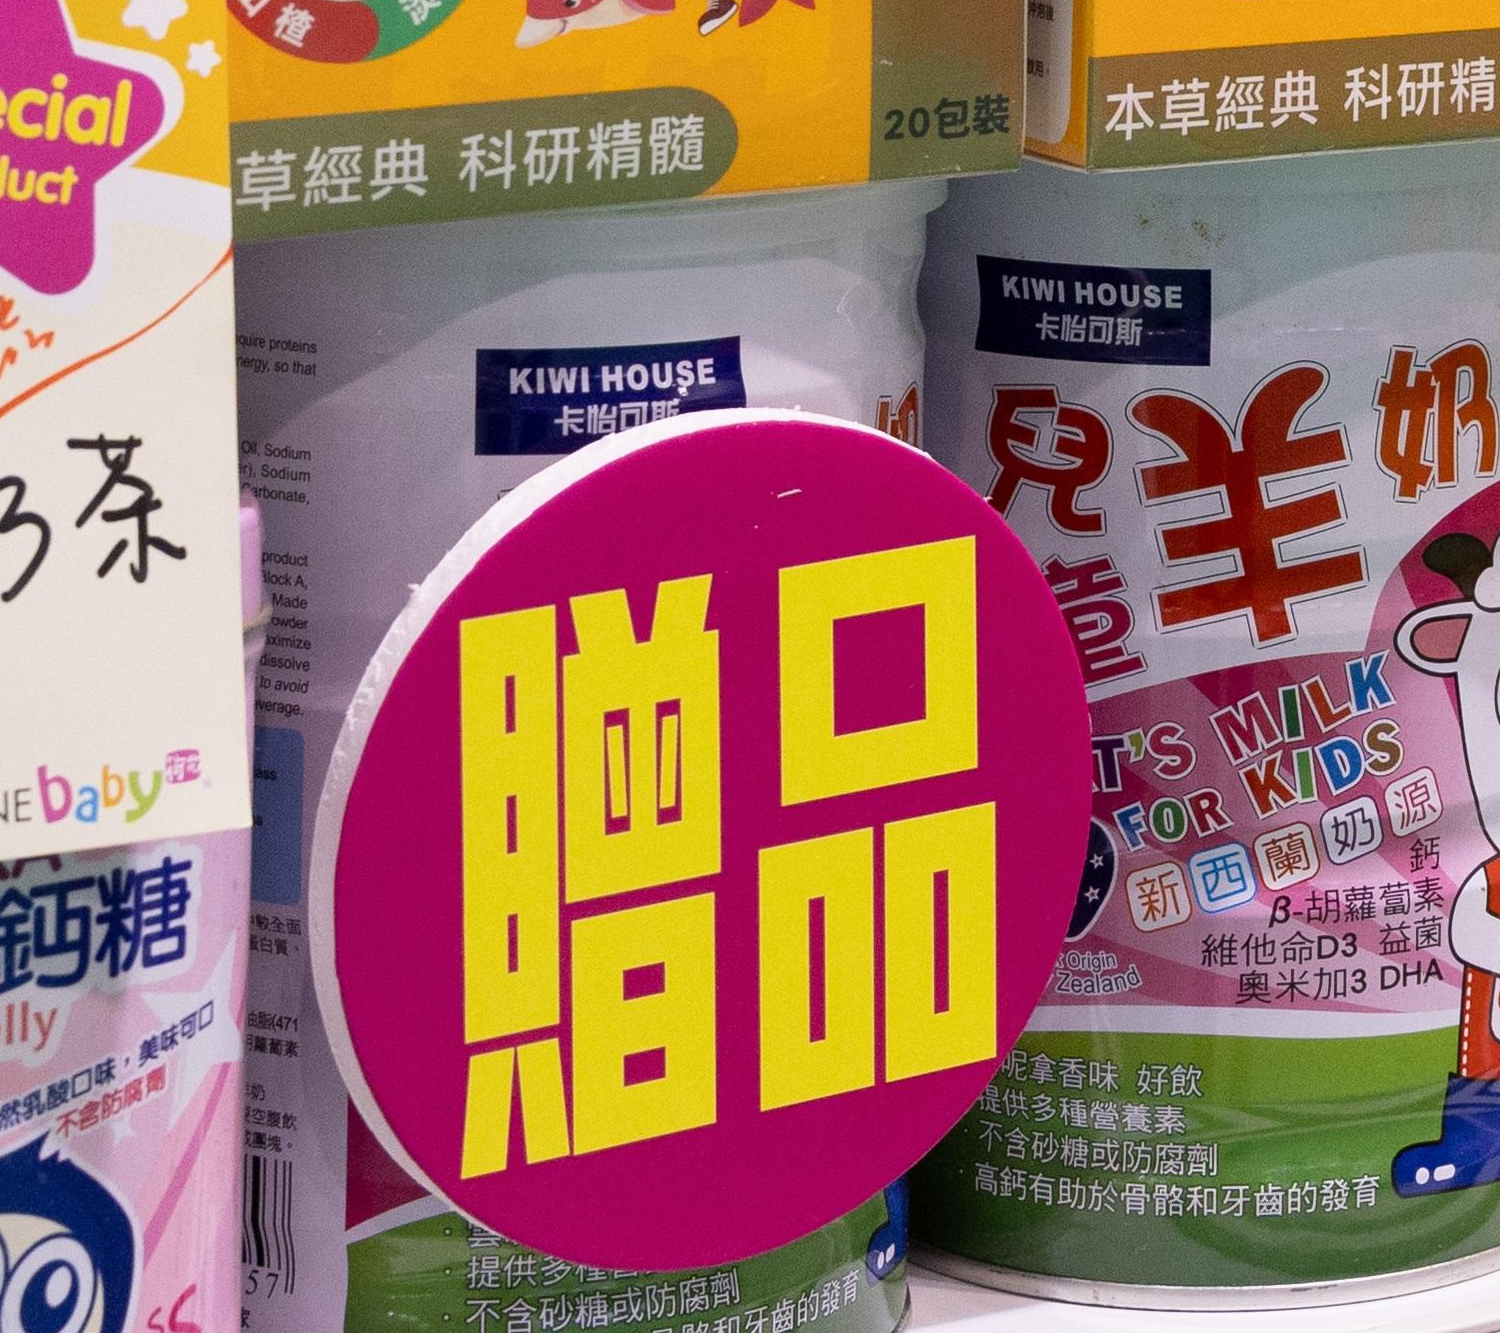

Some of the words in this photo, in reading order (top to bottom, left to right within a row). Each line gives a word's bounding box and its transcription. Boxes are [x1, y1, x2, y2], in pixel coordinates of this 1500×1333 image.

[882, 93, 1012, 142] 20包裝
[1104, 70, 1321, 141] 本草經典
[458, 116, 707, 191] 科研精髓
[1001, 275, 1067, 307] KIWI
[1074, 280, 1184, 311] HOUSE
[1034, 314, 1143, 348] 卡怡可斯
[508, 364, 591, 396] KIWI
[601, 357, 718, 392] HOUSE
[265, 444, 311, 461] Sodium
[260, 654, 310, 672] dissolve
[35, 762, 166, 825] baby
[458, 535, 1000, 1182] 贈品
[1200, 932, 1359, 969] 維他命D3
[1379, 917, 1445, 953] 益菌
[1234, 964, 1368, 1004] 奧米加3
[1378, 957, 1445, 995] DHA
[979, 1122, 1219, 1177] 不含砂糖或防腐劑
[974, 1162, 1381, 1220] 高鈣有助於骨骼和牙齒的發育
